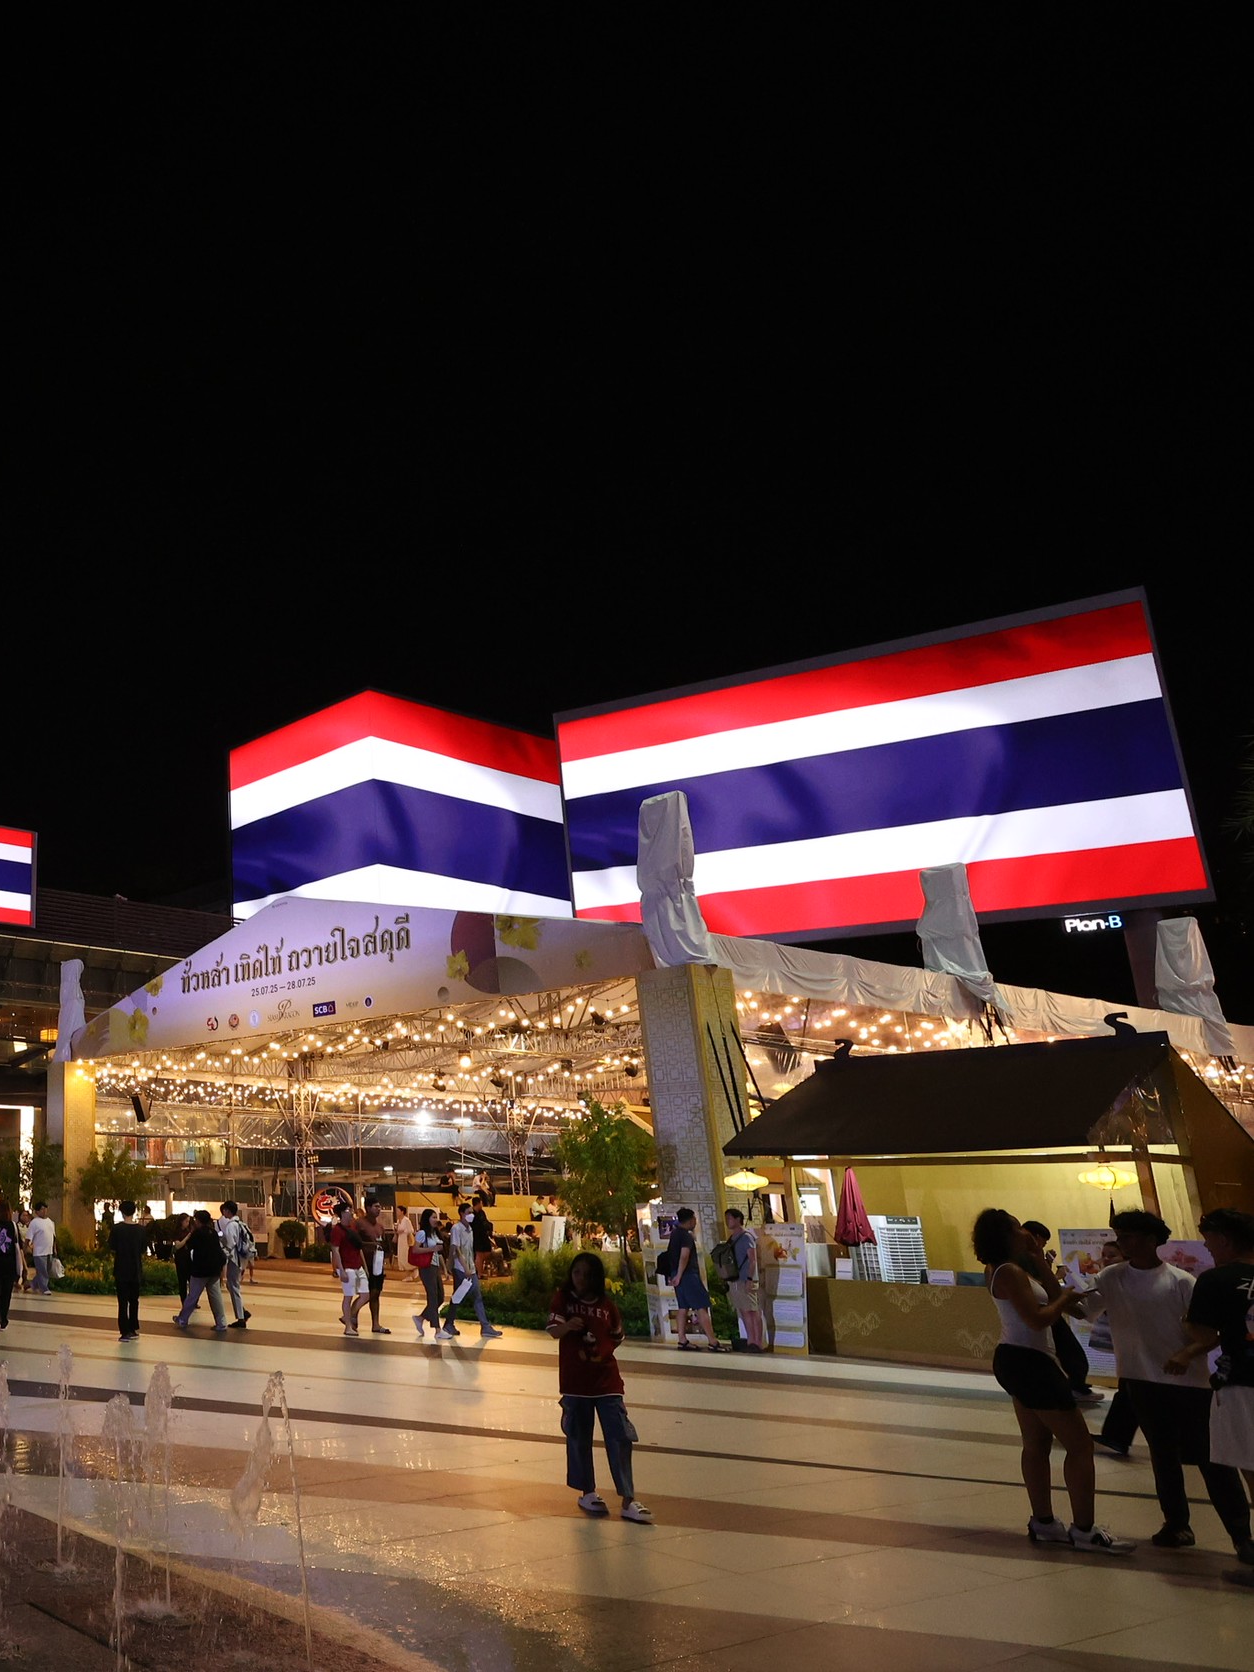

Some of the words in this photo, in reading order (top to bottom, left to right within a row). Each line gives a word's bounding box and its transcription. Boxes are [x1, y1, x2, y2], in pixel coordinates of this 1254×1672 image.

[251, 984, 278, 997] 25.07.25
[286, 976, 316, 990] 28.07.25
[314, 1005, 328, 1015] SCB
[566, 1303, 610, 1321] MICKEY
